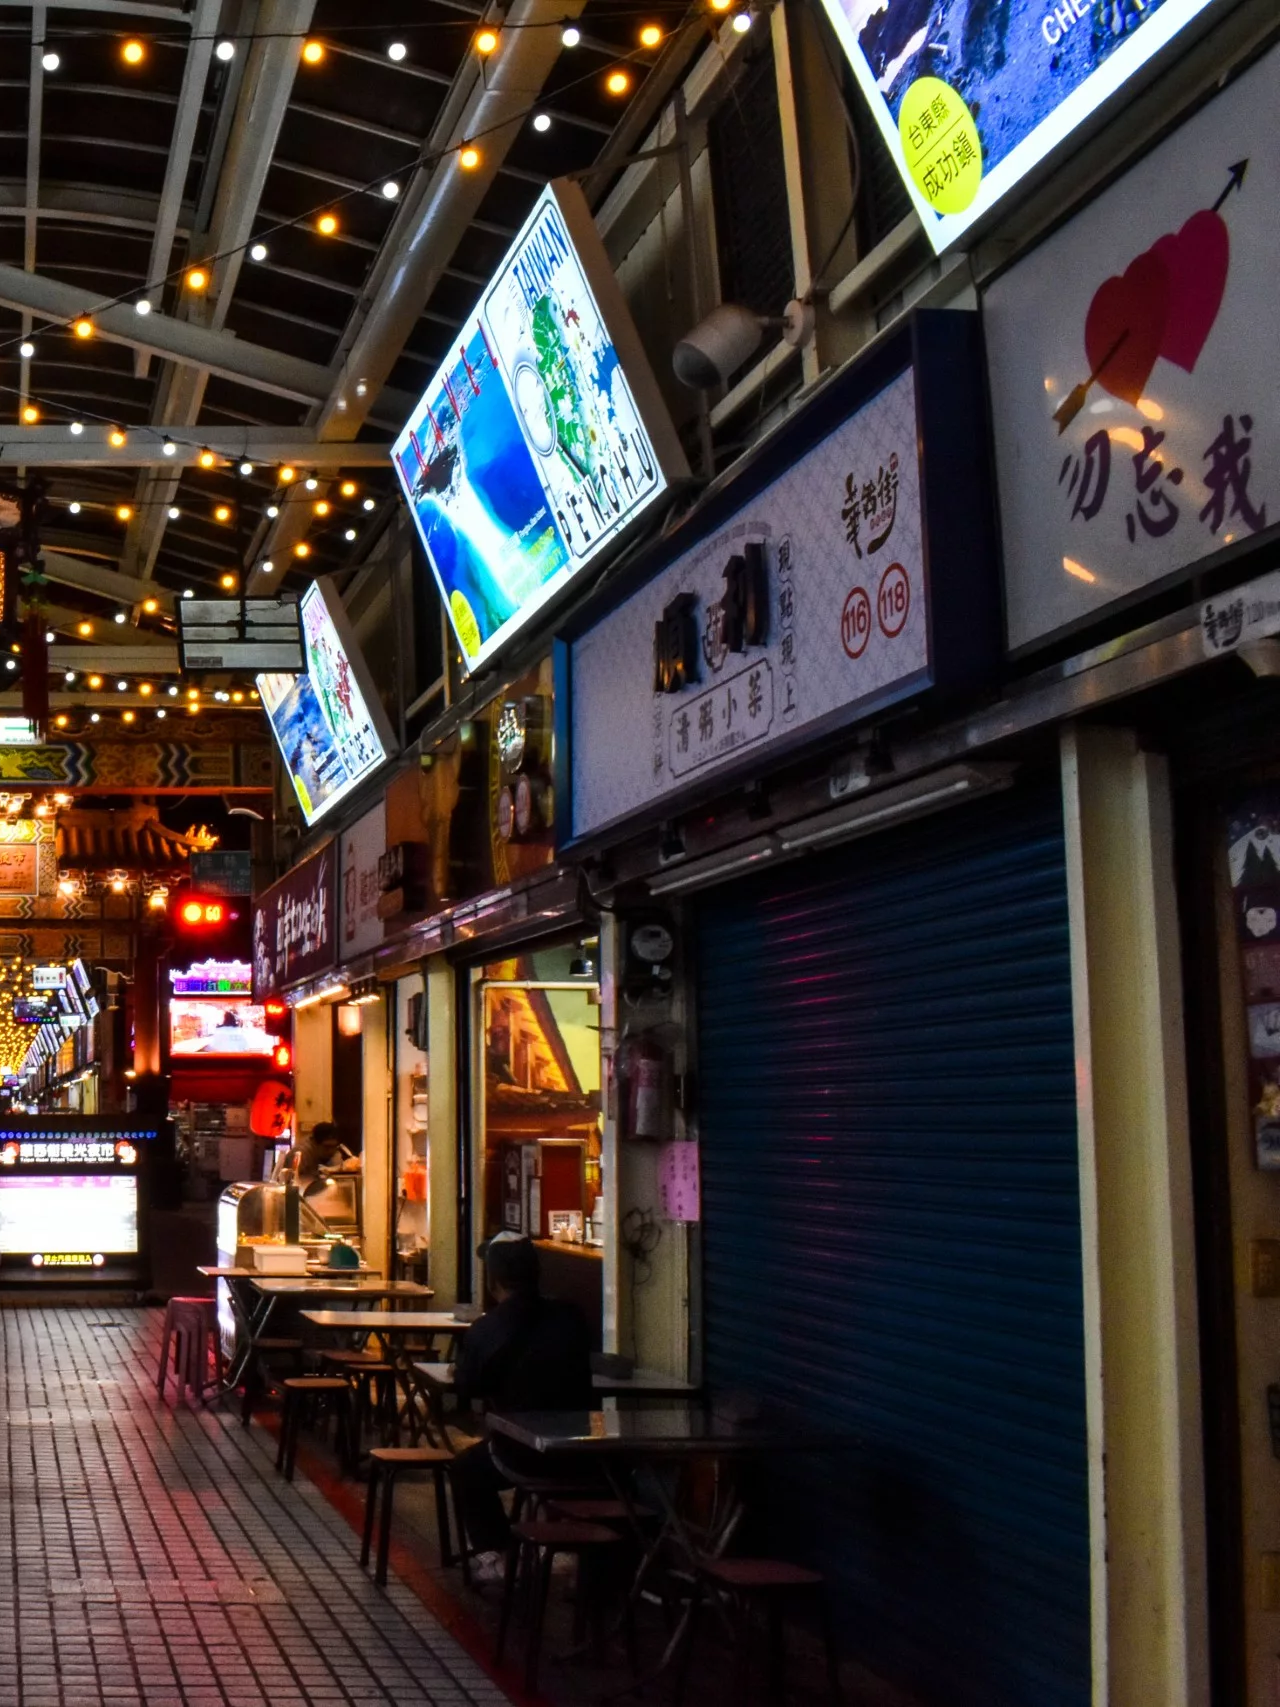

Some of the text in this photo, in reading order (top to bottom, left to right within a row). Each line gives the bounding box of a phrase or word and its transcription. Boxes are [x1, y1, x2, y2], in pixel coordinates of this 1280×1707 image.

[907, 93, 951, 149] 台東縣
[922, 129, 977, 200] 成功鎮
[513, 209, 569, 311] TAIWAN
[396, 318, 499, 496] TRAVEL
[557, 427, 654, 556] PENGHU
[1058, 413, 1266, 543] 勿忘我
[844, 580, 906, 643] 116 118
